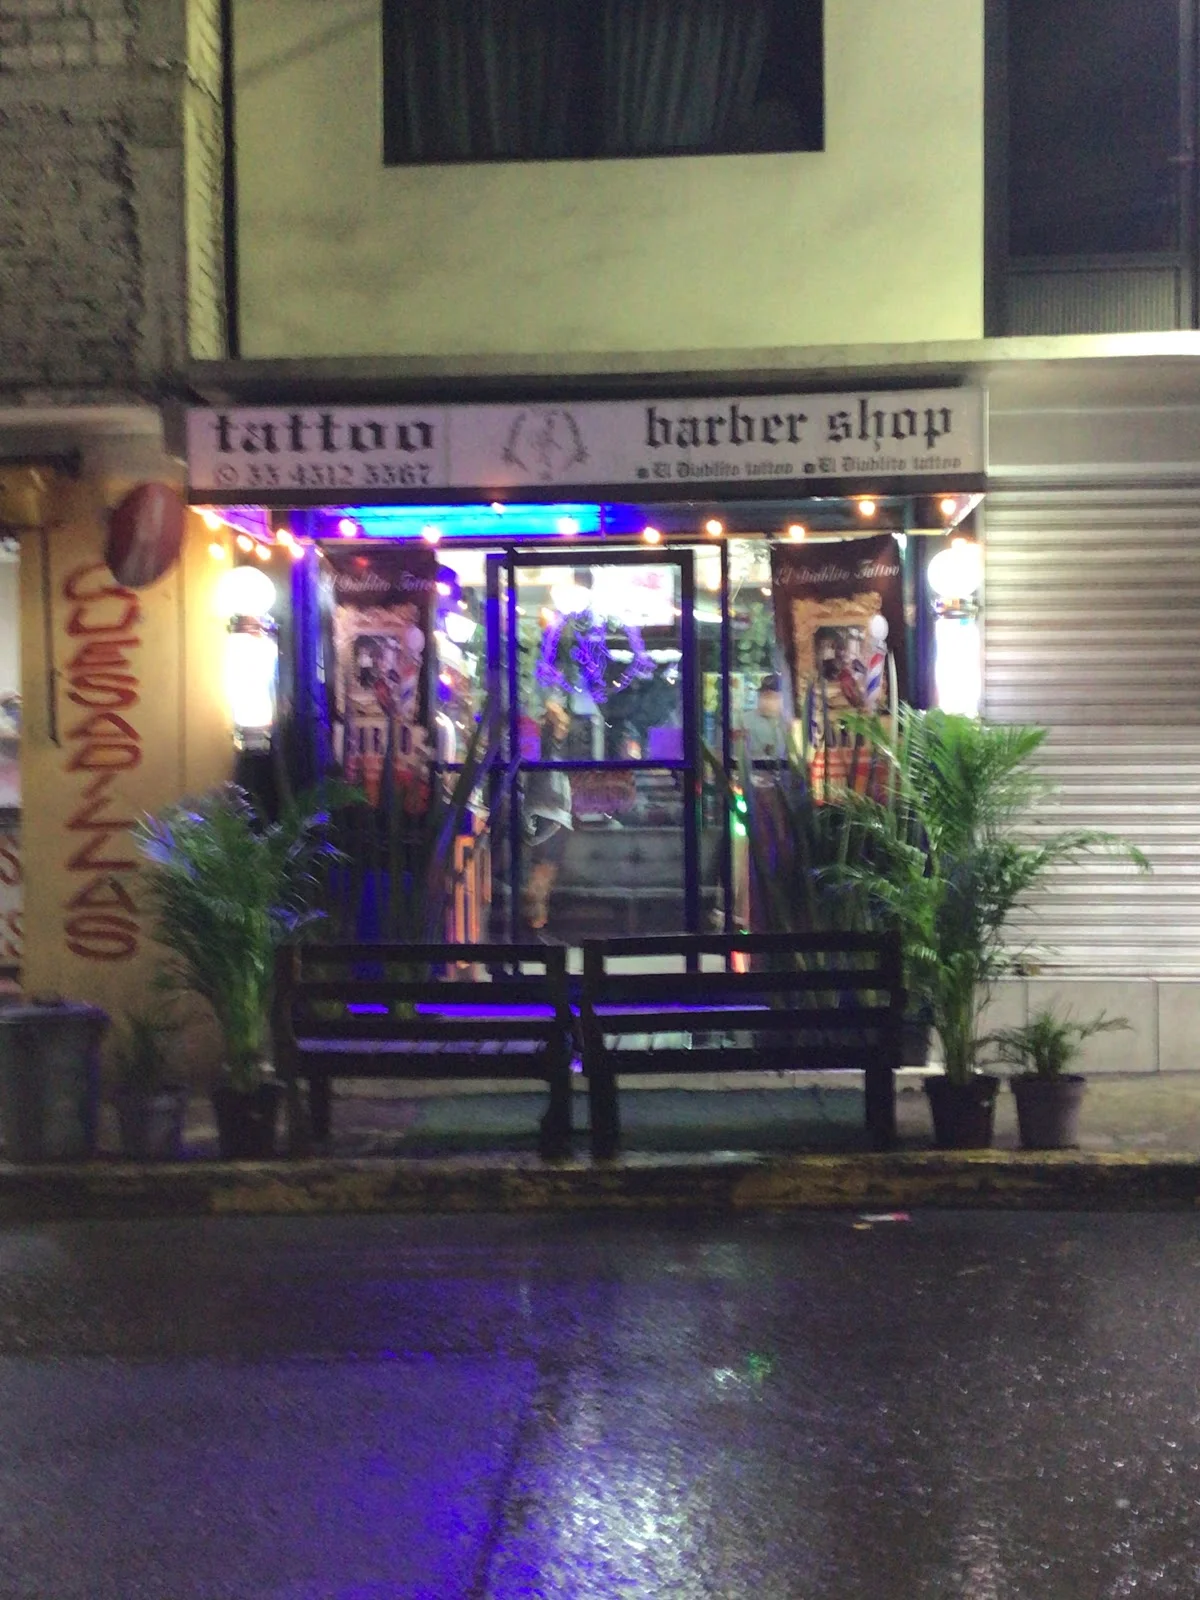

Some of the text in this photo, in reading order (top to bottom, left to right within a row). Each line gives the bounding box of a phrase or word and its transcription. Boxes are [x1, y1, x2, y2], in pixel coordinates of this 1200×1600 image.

[208, 413, 434, 453] tattoo
[645, 399, 953, 451] barber shop
